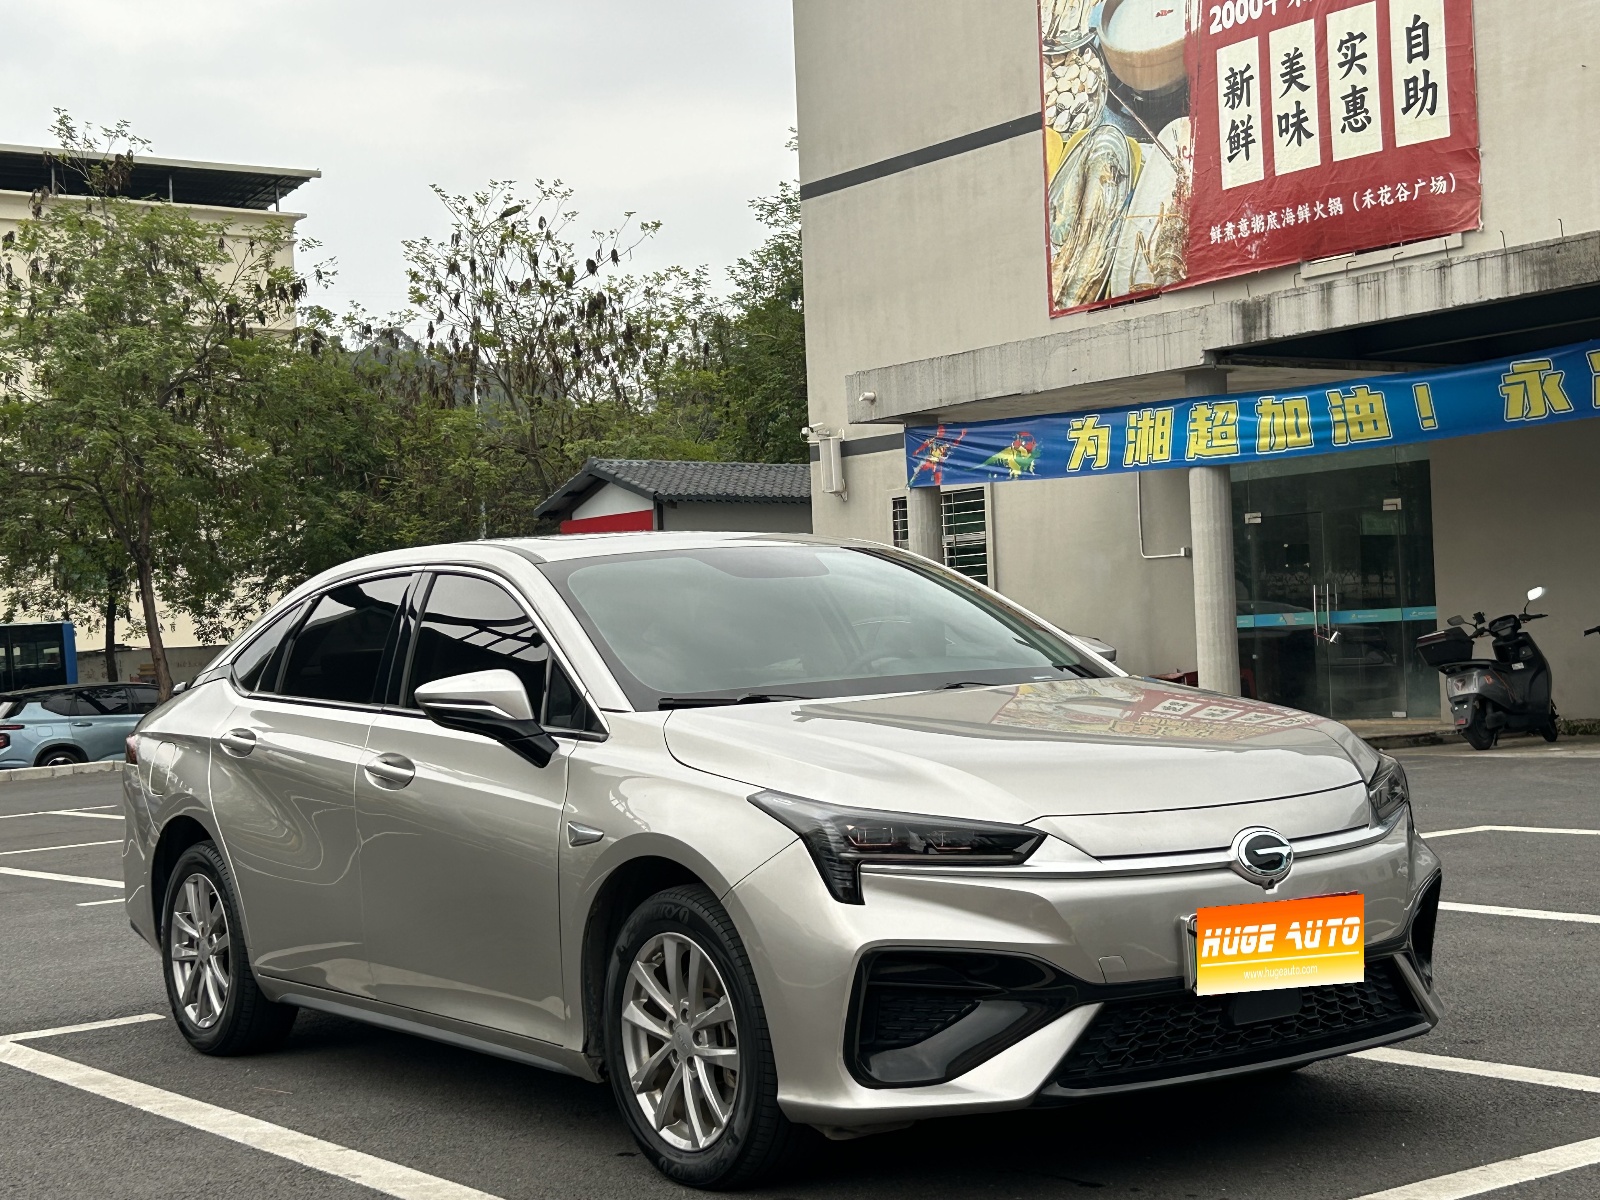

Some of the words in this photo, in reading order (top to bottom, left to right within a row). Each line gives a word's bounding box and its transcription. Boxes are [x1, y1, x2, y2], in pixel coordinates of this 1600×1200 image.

[1223, 63, 1256, 163] 新鲜
[1276, 46, 1315, 147] 美味
[1337, 31, 1372, 134] 实惠
[1401, 14, 1438, 119] 自助
